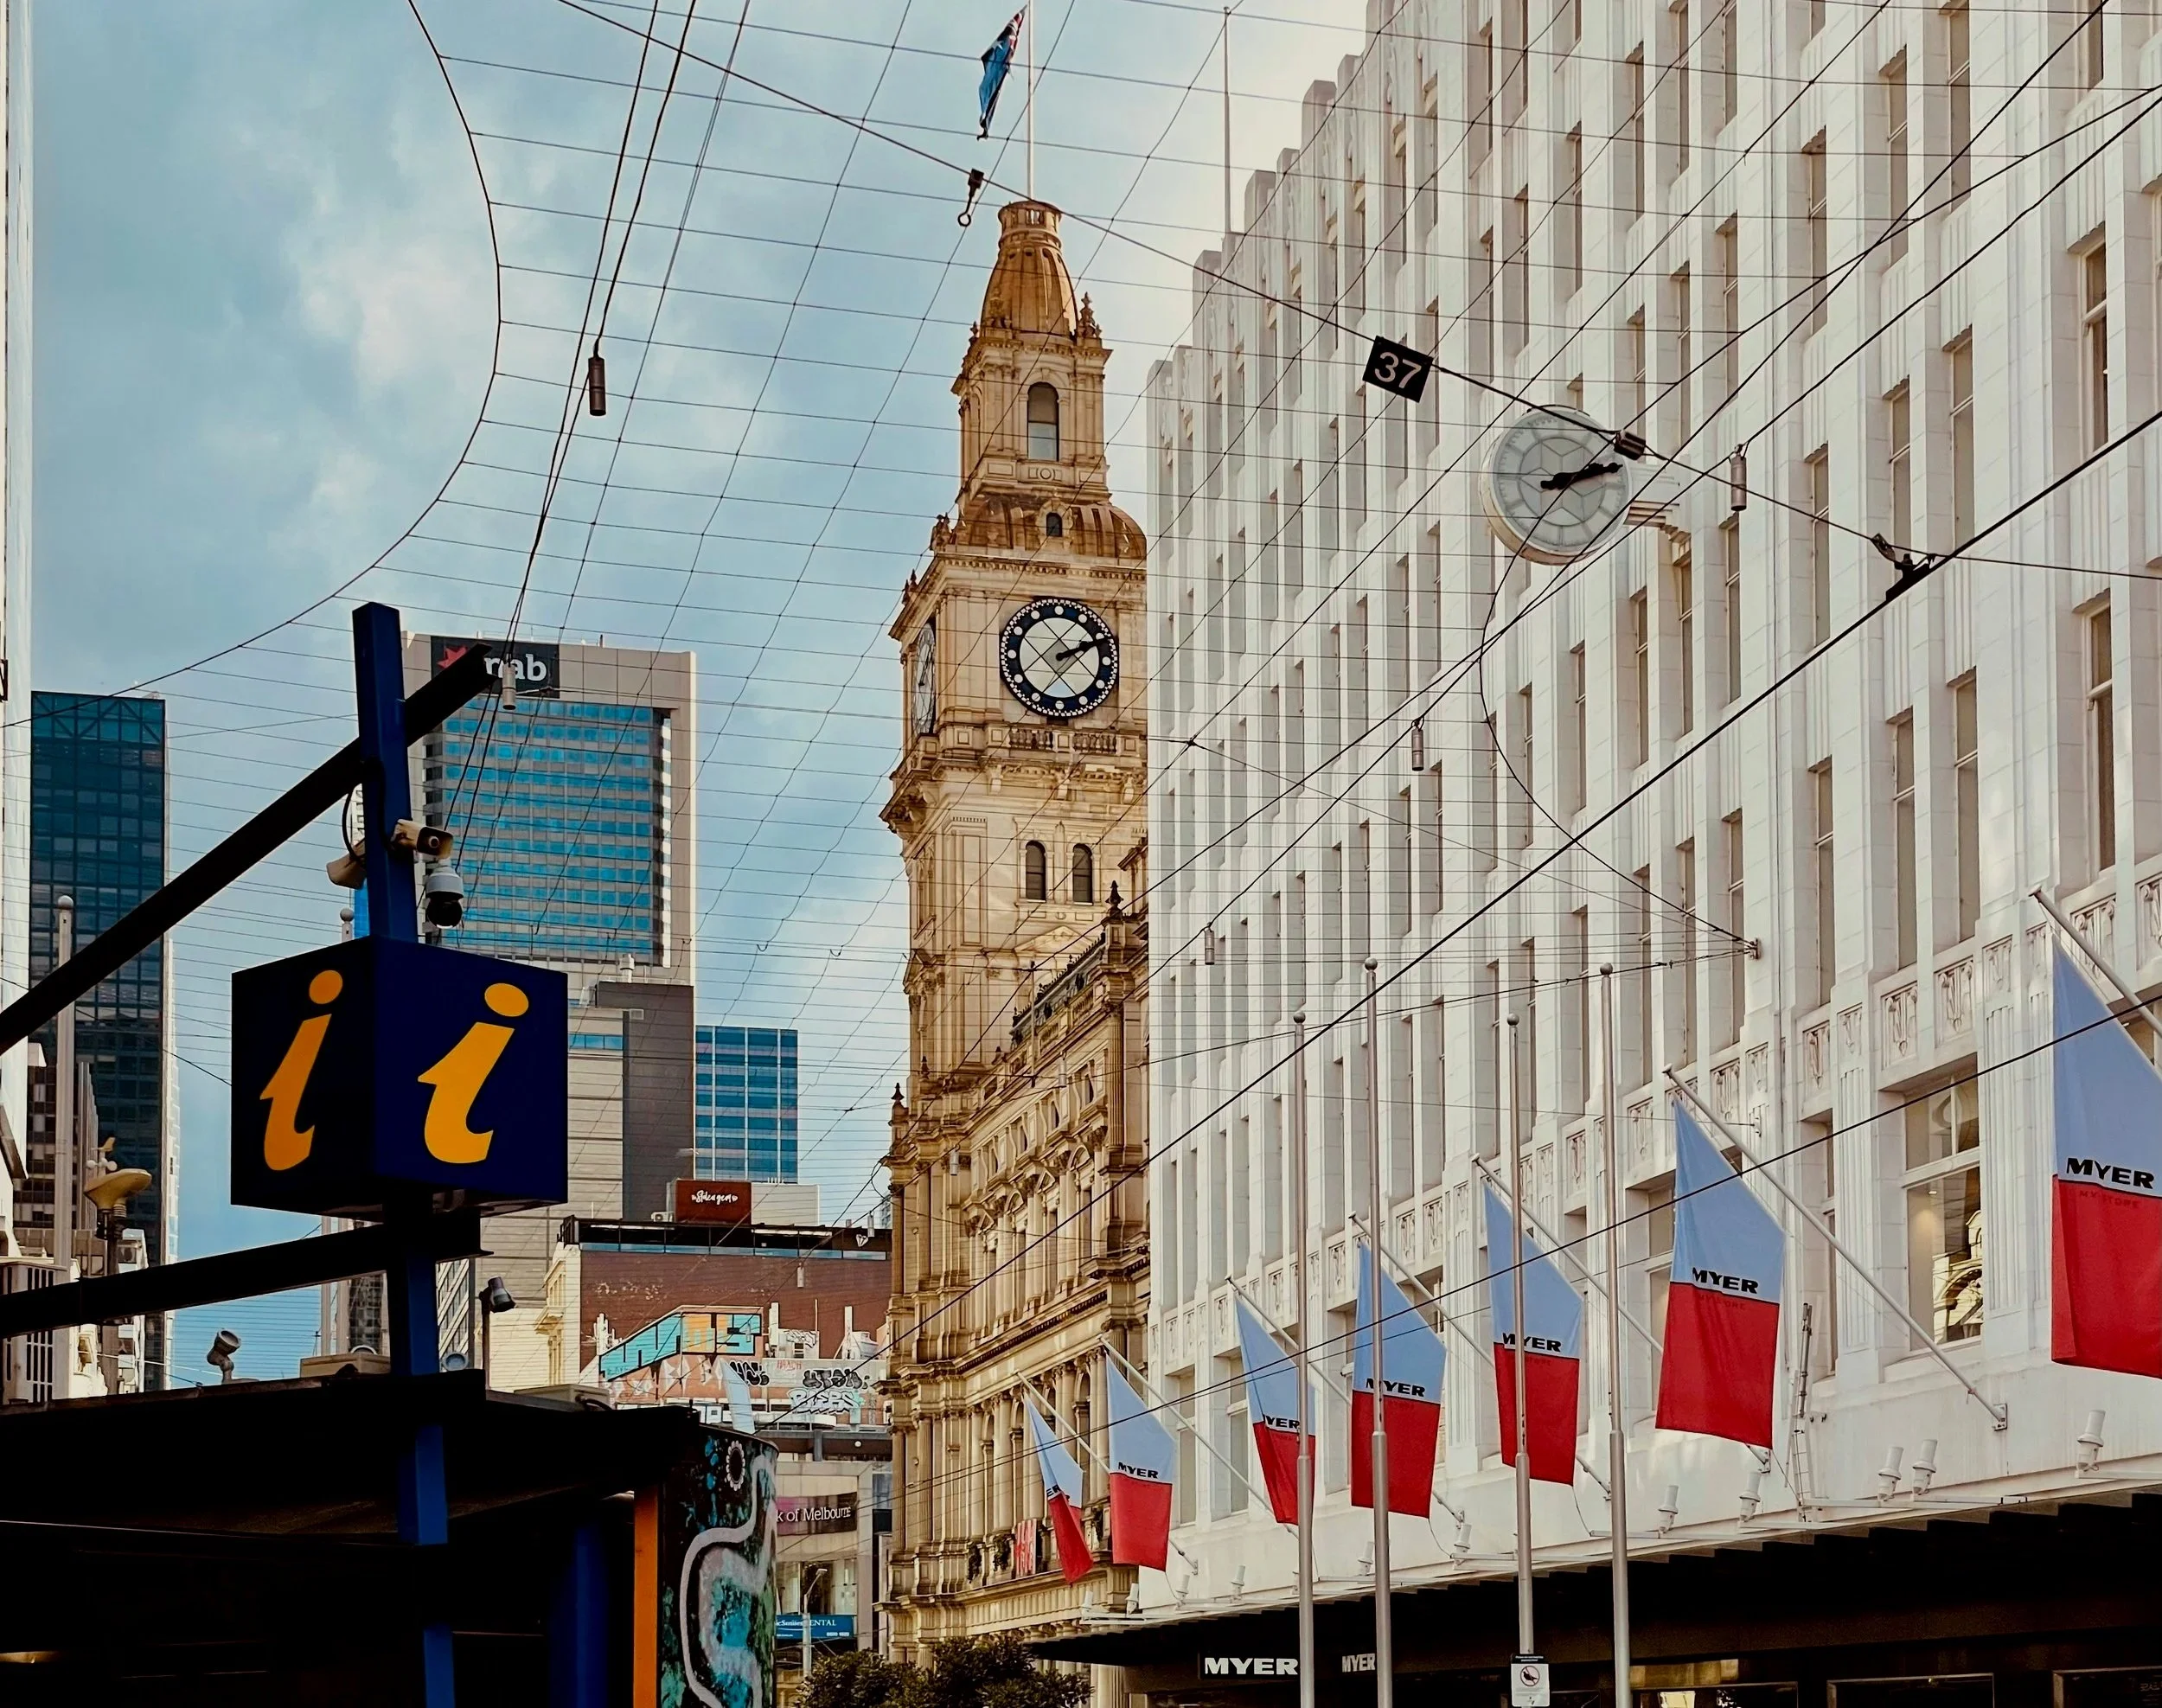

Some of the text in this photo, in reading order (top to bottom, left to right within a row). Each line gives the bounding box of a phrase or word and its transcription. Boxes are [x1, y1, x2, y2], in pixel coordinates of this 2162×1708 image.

[1374, 351, 1423, 389] 37
[483, 653, 547, 681] nab
[259, 969, 343, 1171] i
[418, 982, 529, 1164] i
[2066, 1157, 2155, 1190] MYER
[1692, 1267, 1759, 1294] MYER
[1263, 1414, 1300, 1430] YER
[1118, 1462, 1159, 1479] MYER
[1046, 1484, 1062, 1497] ER
[786, 1508, 801, 1522] of
[1205, 1657, 1299, 1675] MYER
[1342, 1653, 1376, 1673] MYER
